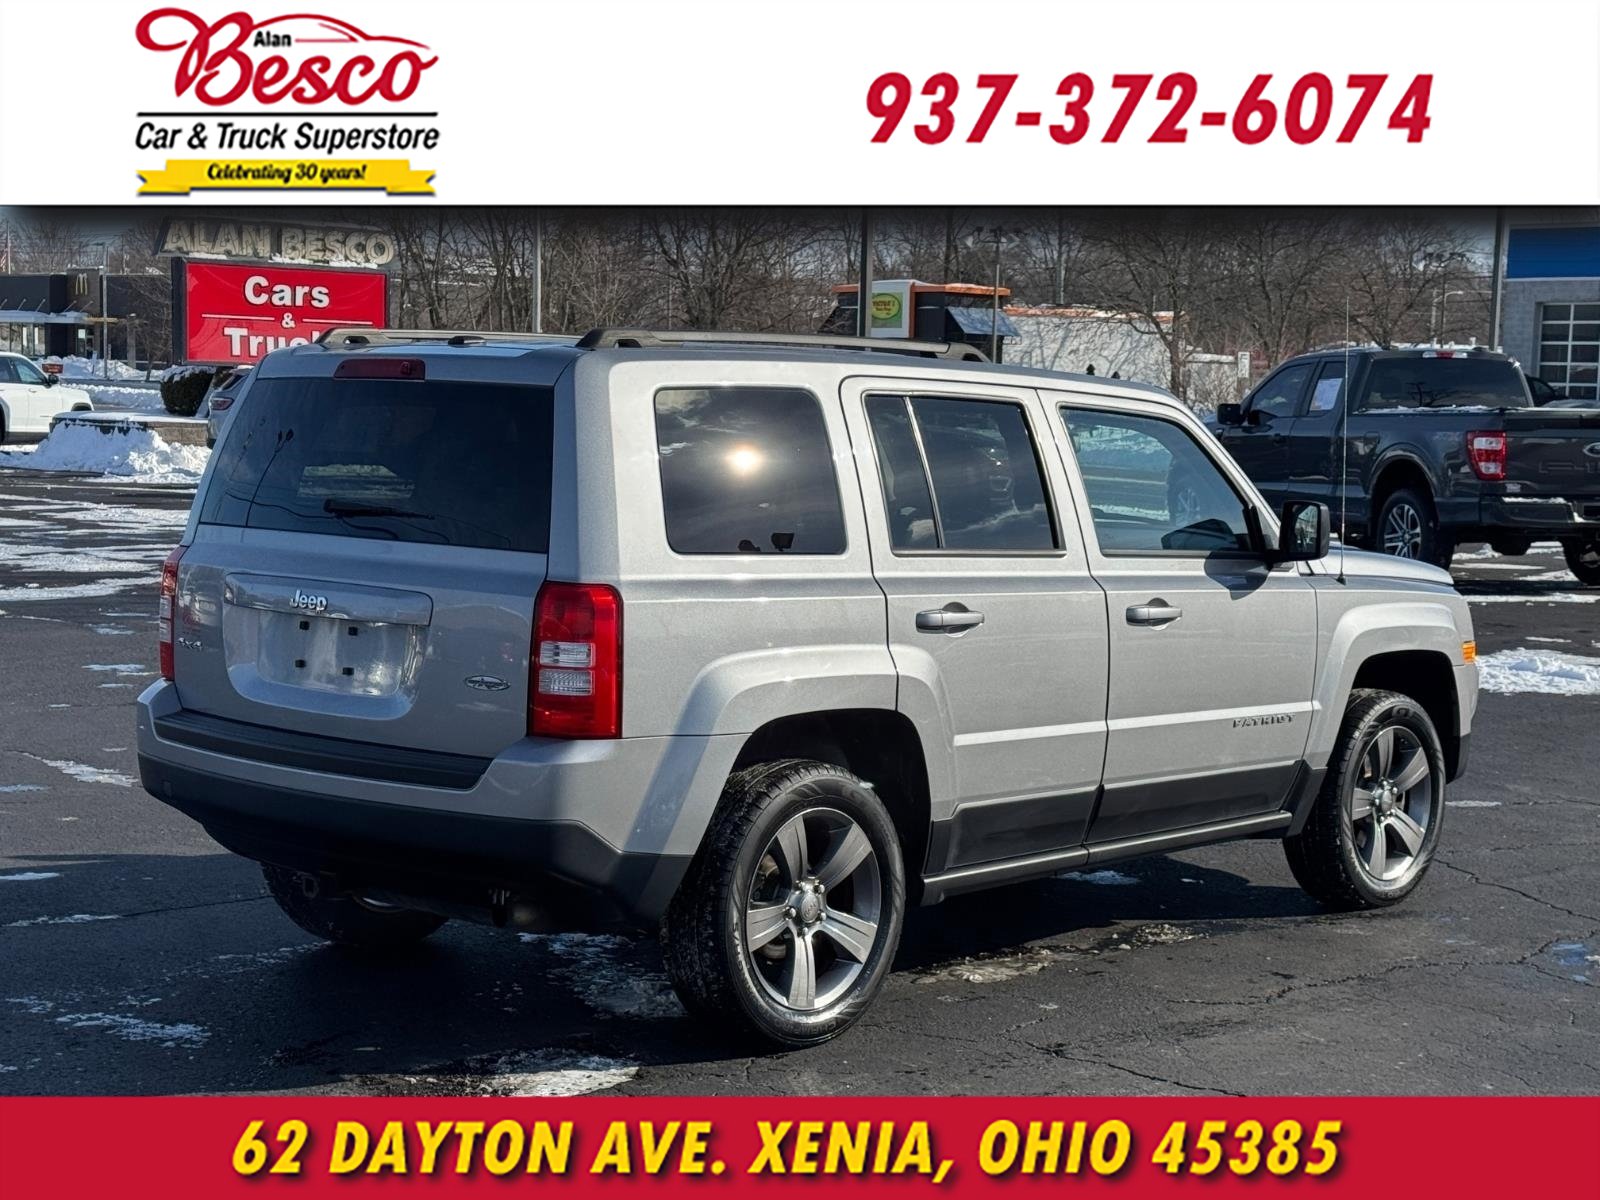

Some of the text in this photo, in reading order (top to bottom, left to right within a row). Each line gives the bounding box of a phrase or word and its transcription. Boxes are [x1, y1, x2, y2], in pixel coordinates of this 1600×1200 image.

[163, 220, 394, 265] ALAN BESCO
[244, 275, 330, 308] Cars
[281, 312, 296, 328] &
[289, 589, 328, 614] Jeep
[1232, 714, 1295, 728] PATRIOT
